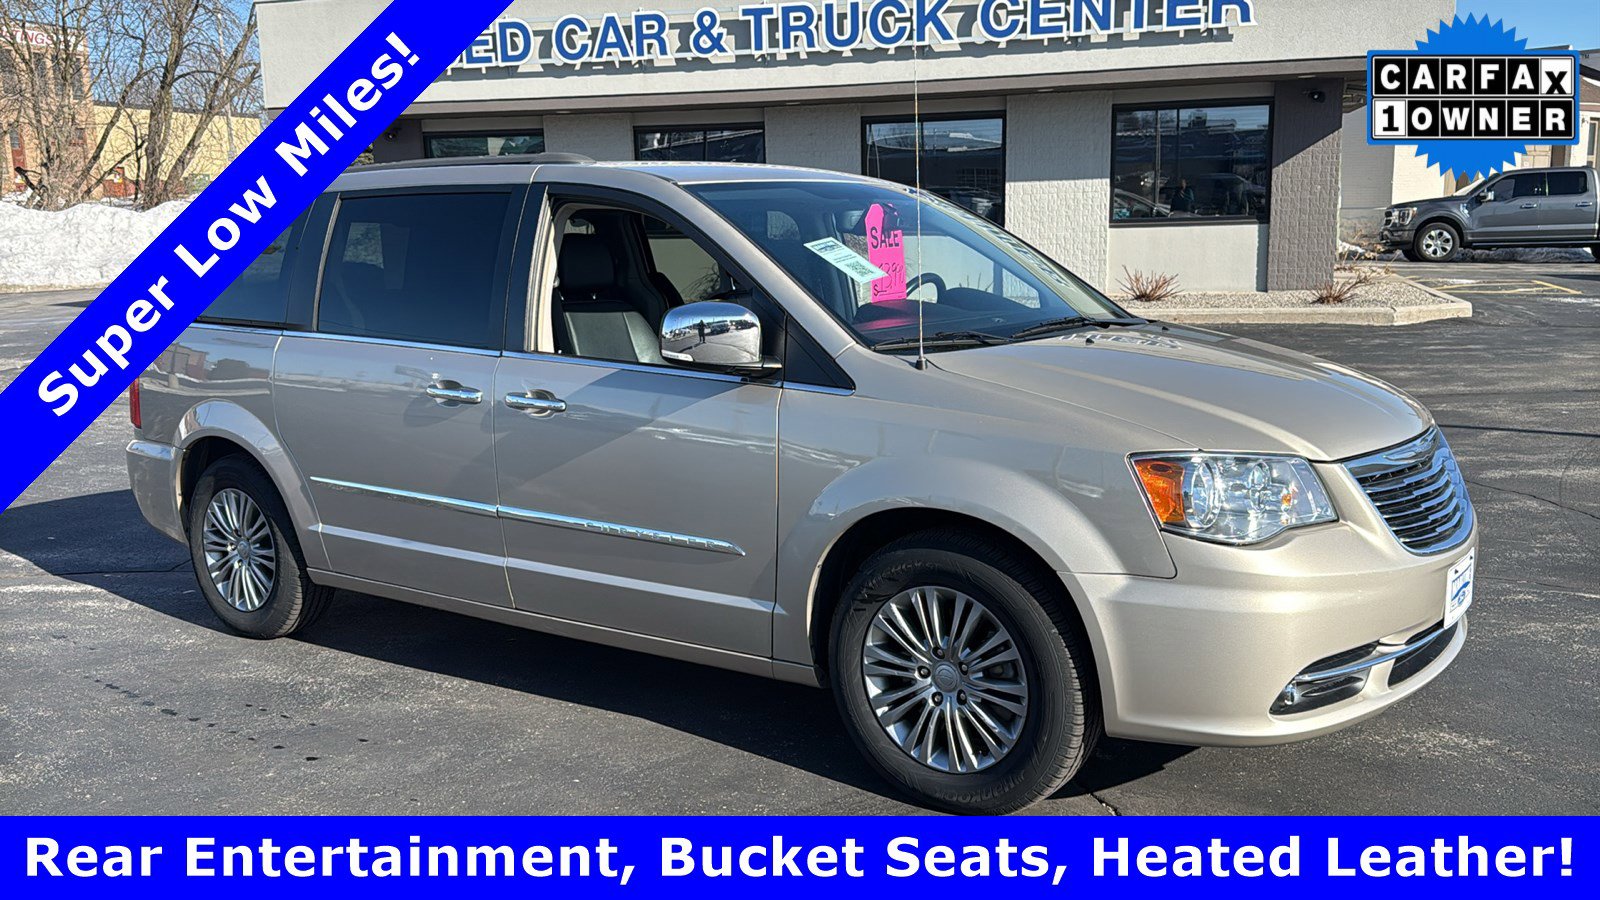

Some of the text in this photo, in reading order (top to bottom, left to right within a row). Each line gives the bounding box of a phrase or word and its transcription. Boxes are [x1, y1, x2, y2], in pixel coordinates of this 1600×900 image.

[460, 0, 1257, 68] ED CAR & TRUCK CENTER
[870, 226, 900, 250] SALE
